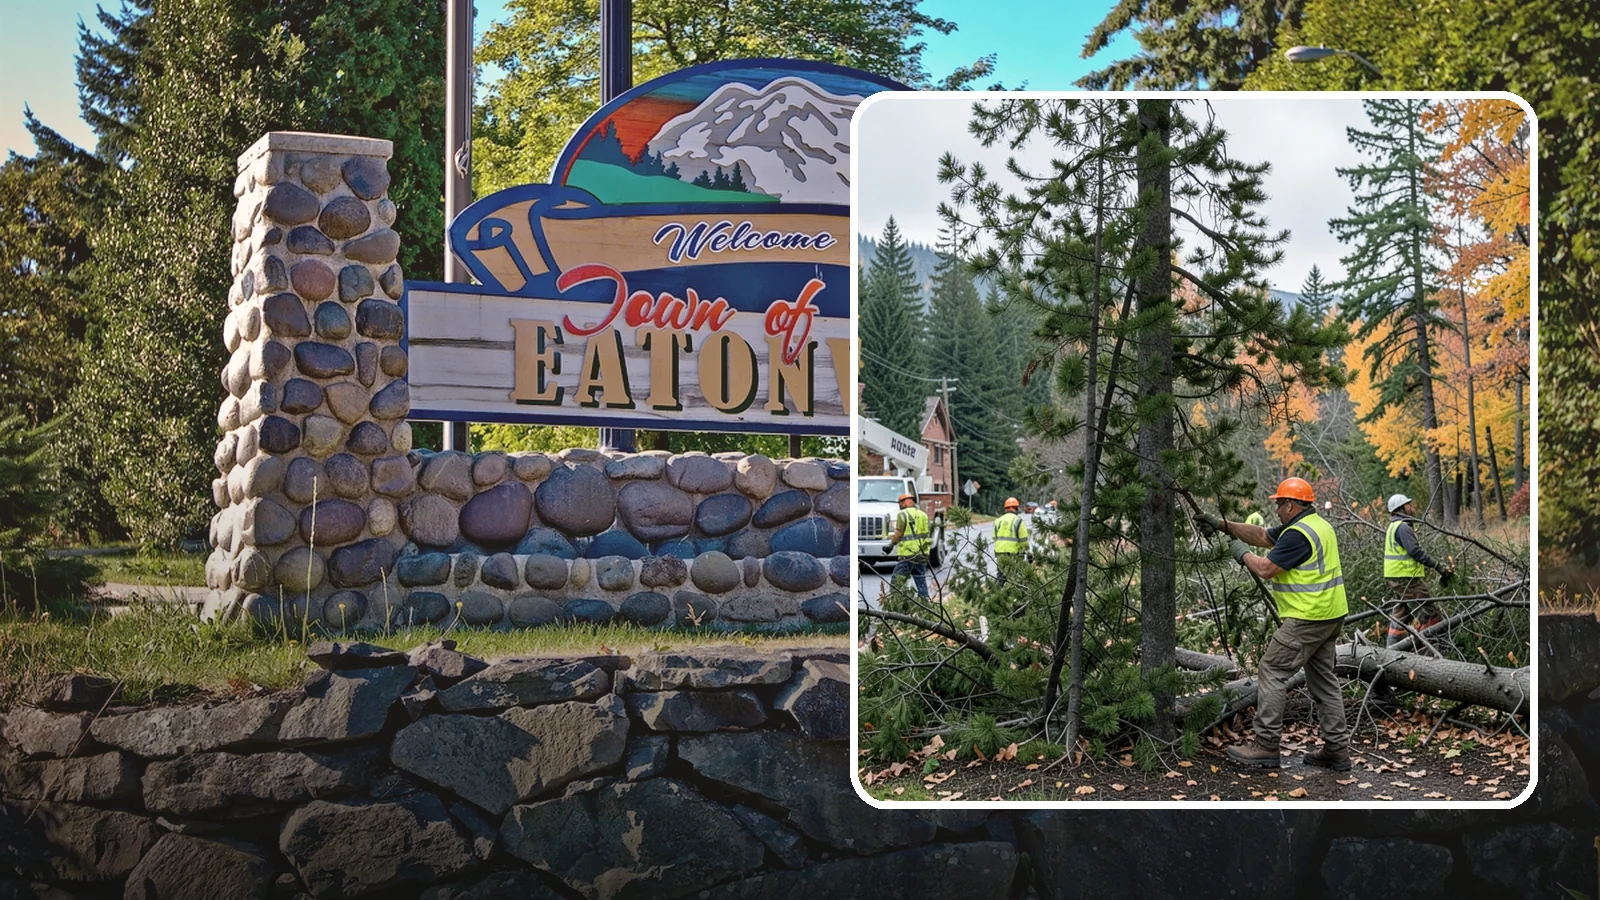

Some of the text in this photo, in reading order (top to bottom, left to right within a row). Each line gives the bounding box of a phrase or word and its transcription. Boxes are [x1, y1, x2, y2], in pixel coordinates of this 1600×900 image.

[653, 220, 837, 263] Welcome
[556, 263, 826, 365] Town of
